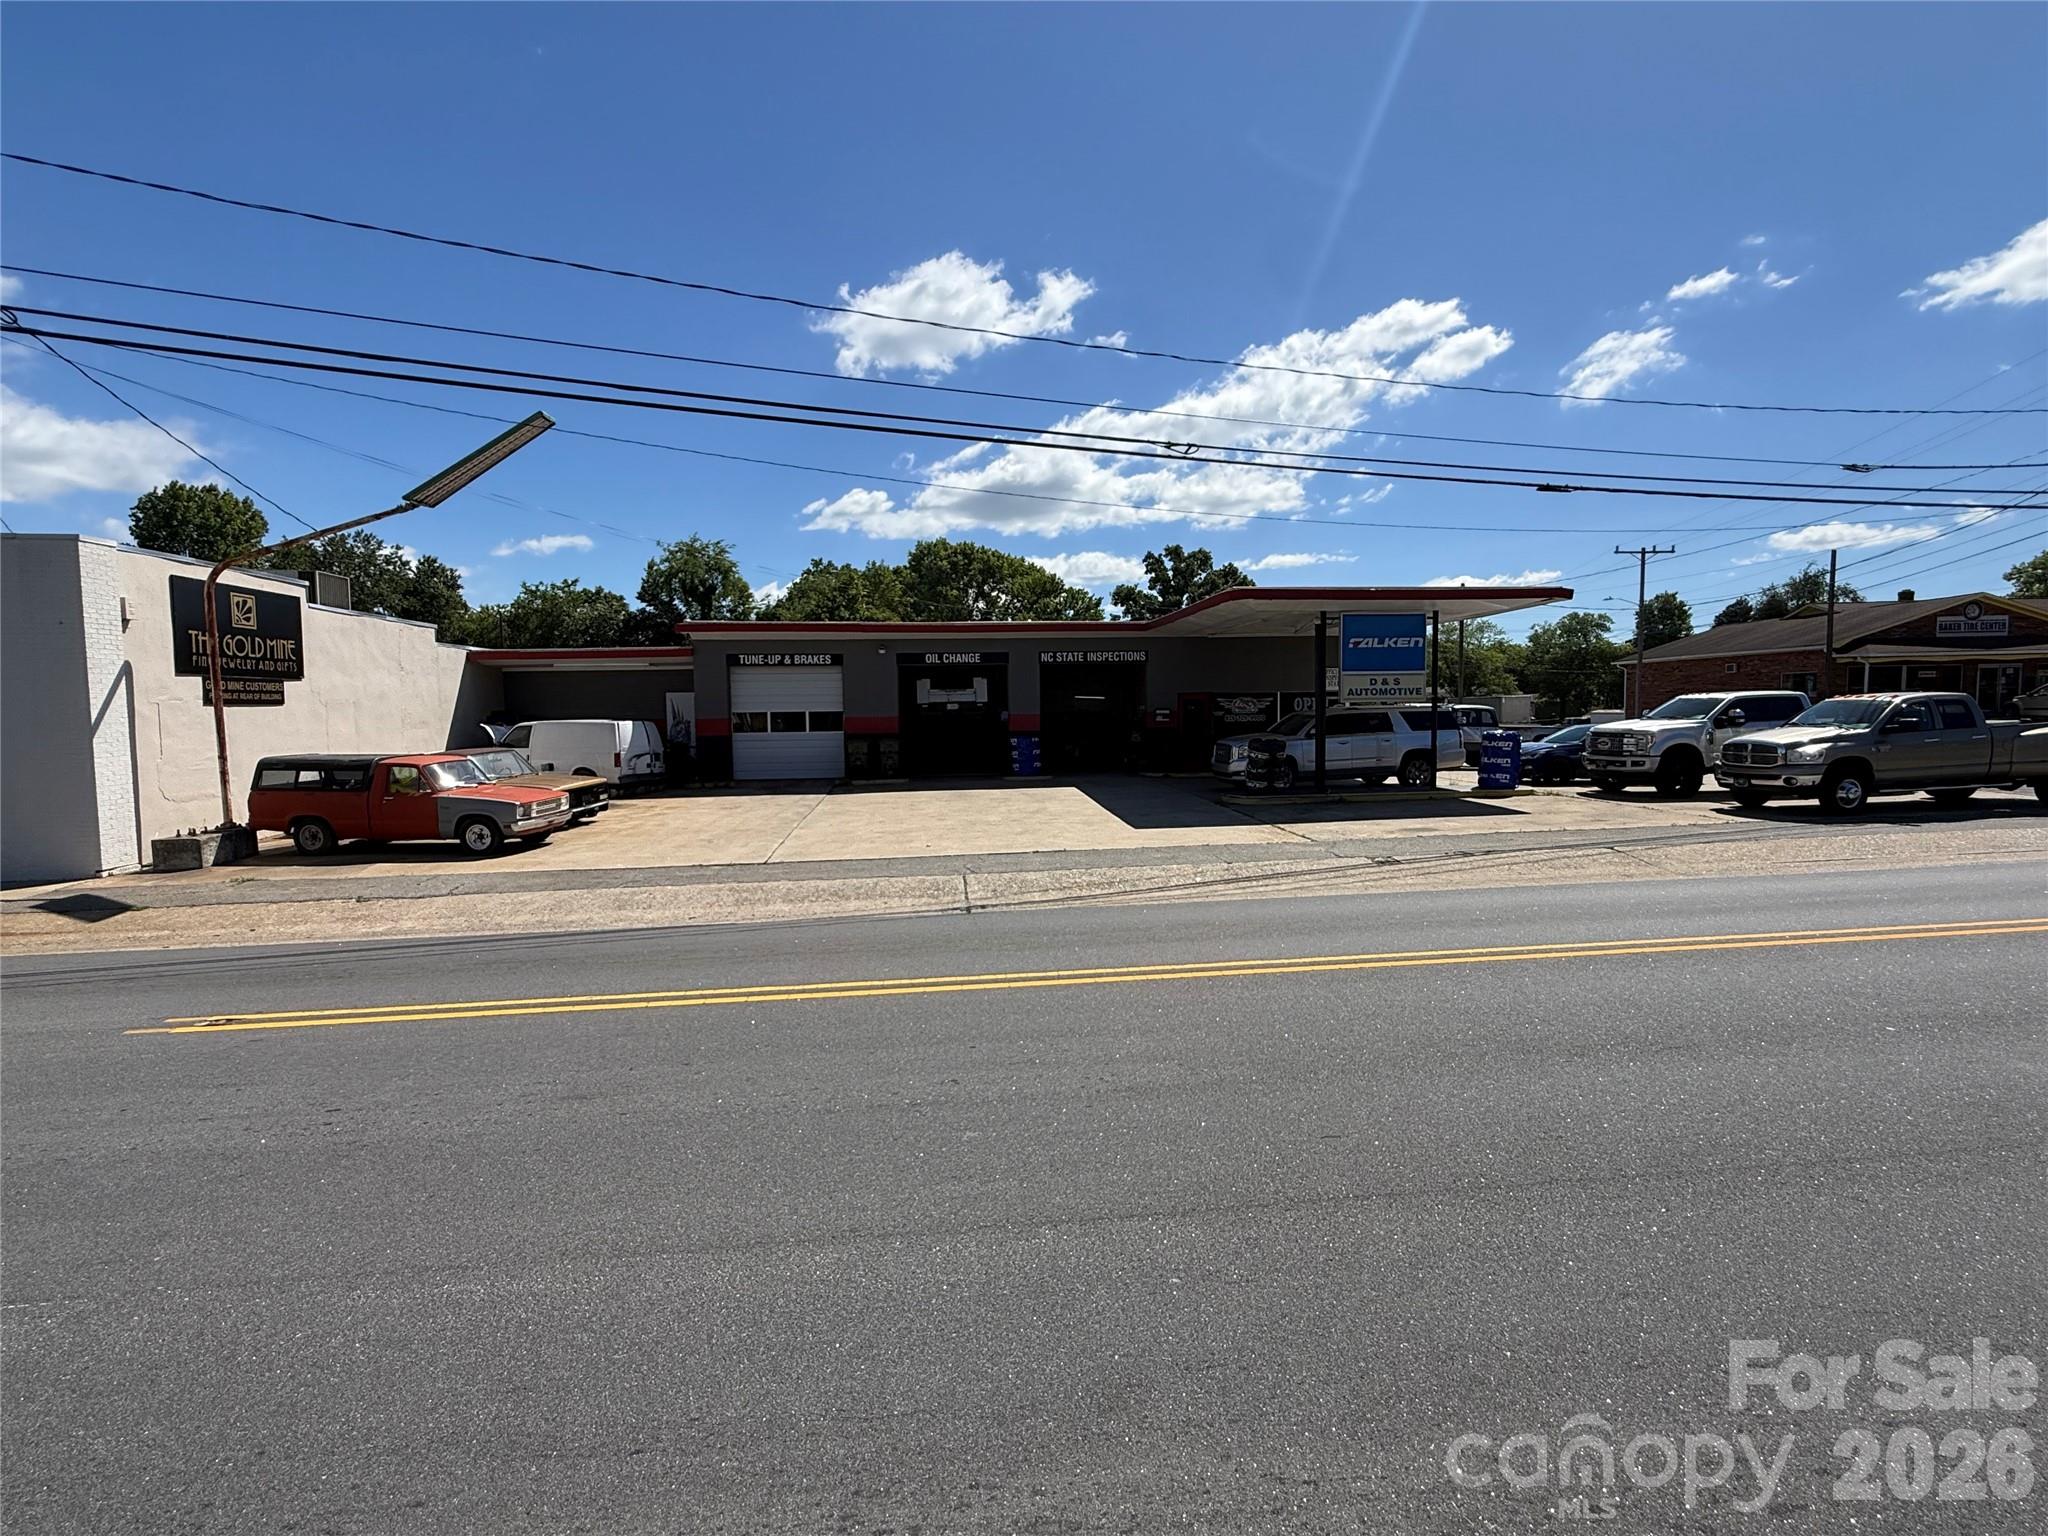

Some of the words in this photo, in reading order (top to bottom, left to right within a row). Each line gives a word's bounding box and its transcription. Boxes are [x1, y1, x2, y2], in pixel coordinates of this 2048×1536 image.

[188, 630, 219, 654] TH
[223, 635, 264, 658] GOLD
[266, 638, 296, 660] MINE
[1348, 637, 1424, 648] FALKEN
[738, 654, 782, 665] TUNE-UP
[784, 655, 792, 665] &
[794, 654, 832, 665] BRAKES
[925, 653, 941, 664] OIL
[942, 652, 981, 664] CHANGE
[1041, 652, 1054, 662] NC
[1056, 651, 1084, 662] STATE
[1087, 651, 1146, 662] INSPECTIONS
[219, 657, 256, 670] EWELRY
[259, 660, 275, 671] AND
[276, 661, 298, 672] GIFTS
[205, 680, 226, 690] GD
[227, 681, 244, 691] MINE
[245, 681, 284, 692] CUSTOMERS
[1369, 678, 1377, 686] D
[1381, 678, 1389, 686] &
[1393, 677, 1401, 686] S
[1347, 687, 1422, 696] AUTOMOTIVE
